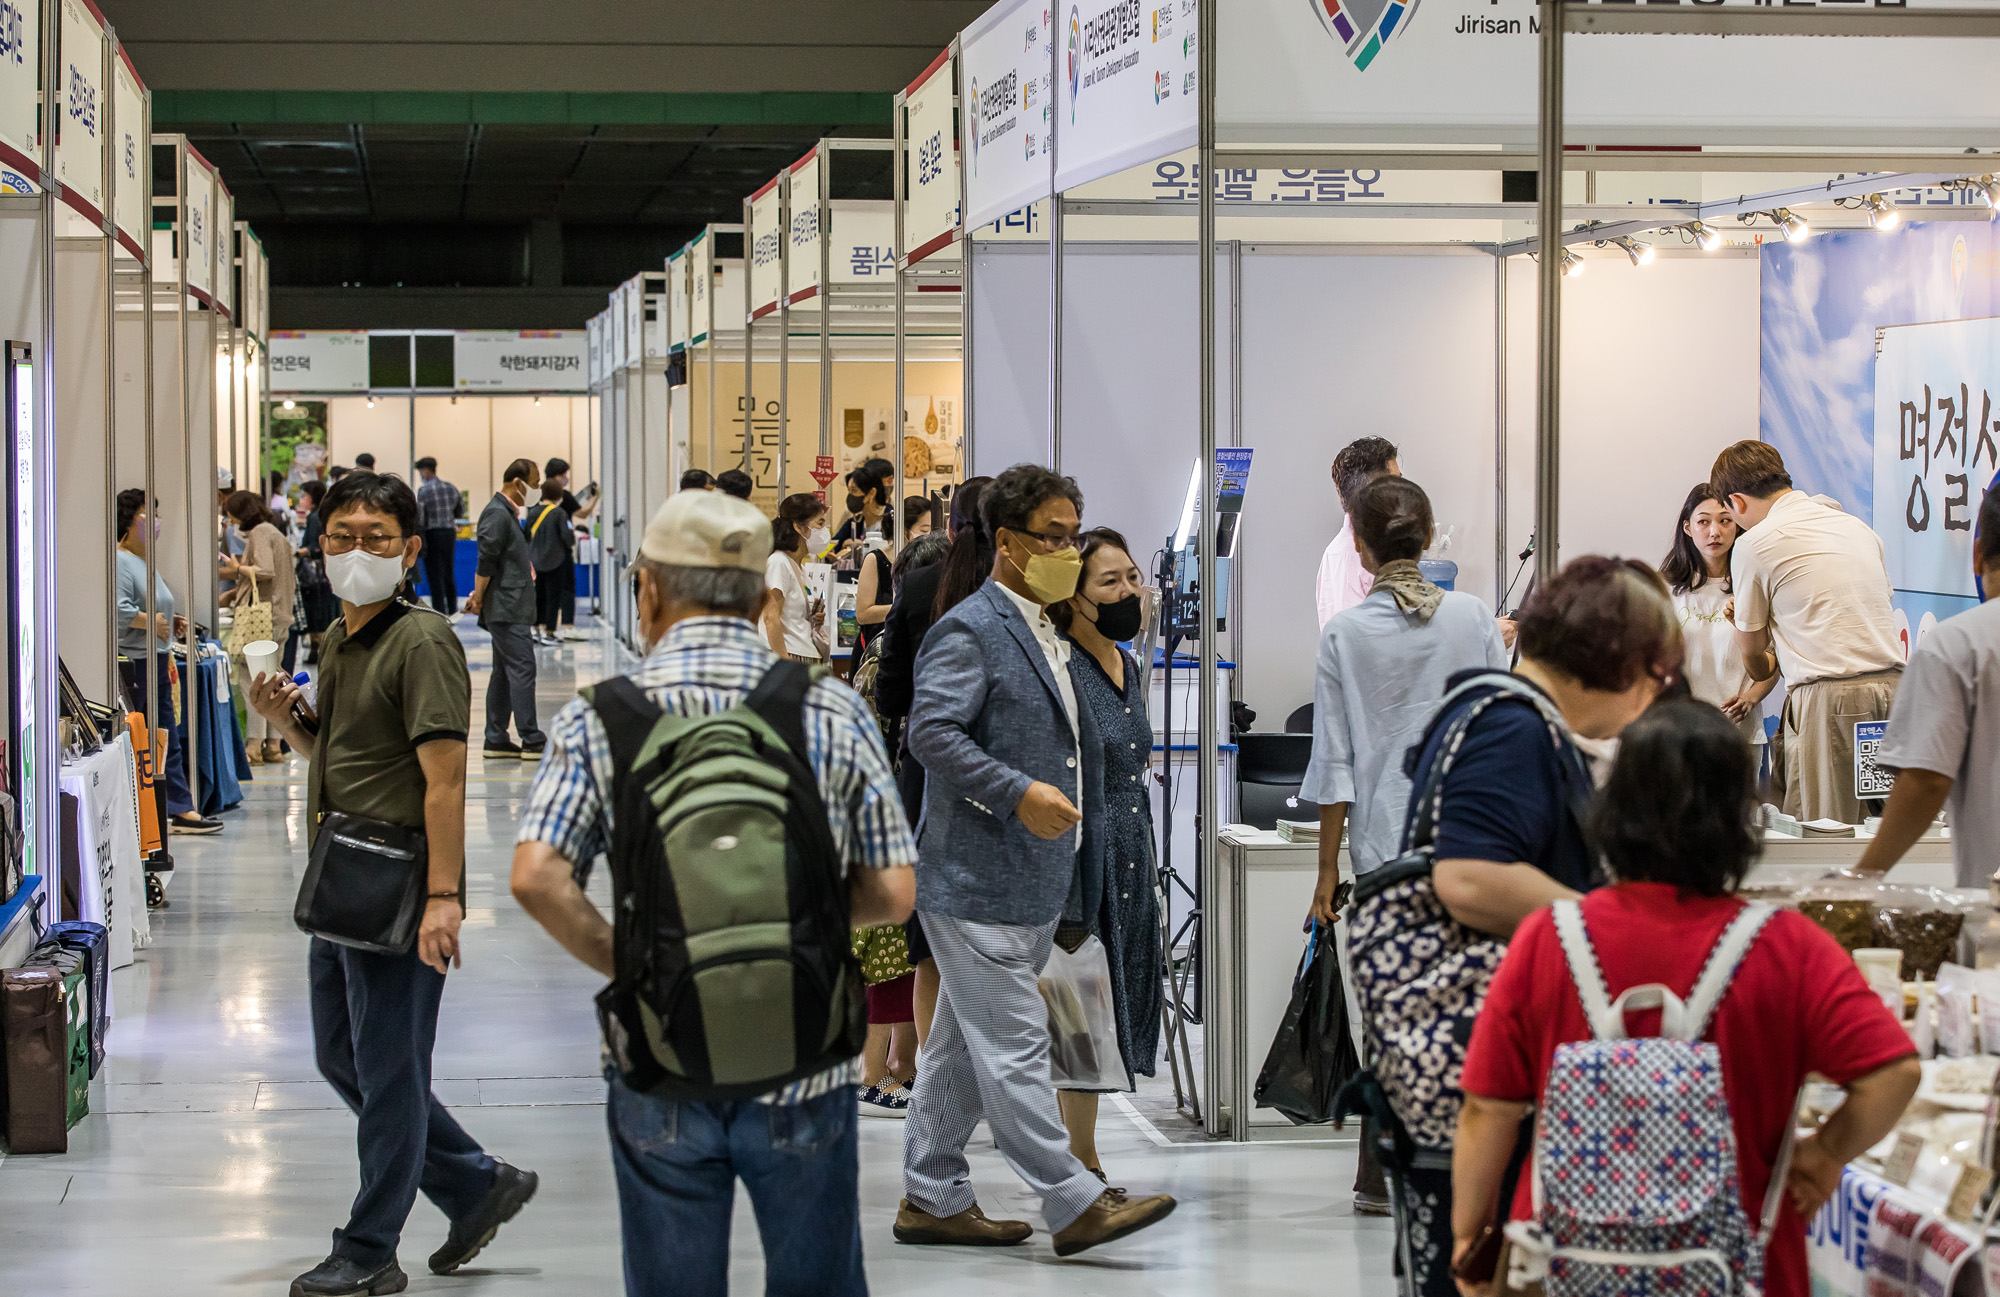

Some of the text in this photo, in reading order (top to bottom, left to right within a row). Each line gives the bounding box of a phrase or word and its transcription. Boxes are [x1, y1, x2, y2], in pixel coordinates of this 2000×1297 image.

[1455, 15, 1520, 34] Jirisan
[500, 354, 580, 371] 착한돼지감자
[1858, 726, 1884, 736] 코엑스
